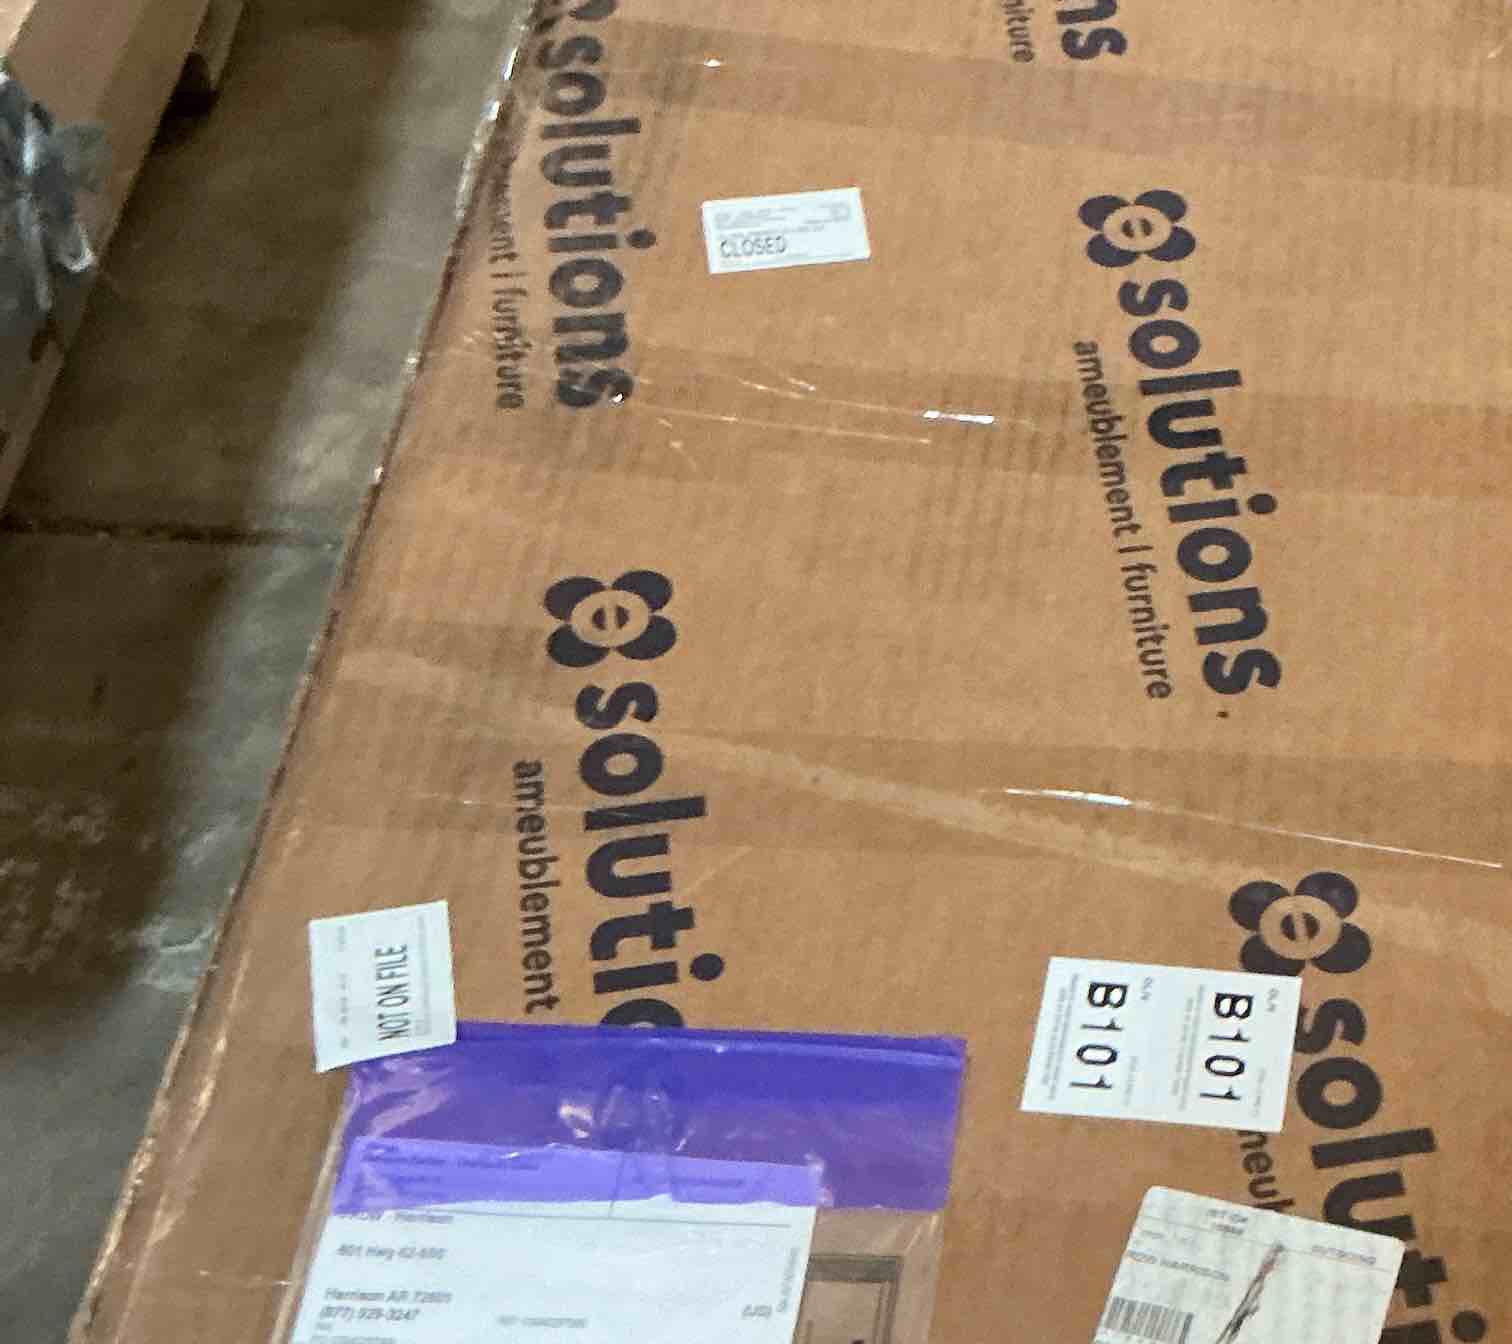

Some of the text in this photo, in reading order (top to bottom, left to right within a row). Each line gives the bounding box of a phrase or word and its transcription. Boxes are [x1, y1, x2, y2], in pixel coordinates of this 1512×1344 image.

[534, 34, 657, 410] solutions
[719, 233, 788, 259] CLOSED
[1073, 339, 1142, 539] ameublement
[1120, 562, 1174, 700] furniture
[1117, 278, 1282, 696] solutions
[512, 759, 562, 1016] ameublement
[374, 942, 411, 1041] NOT ON FILE
[1070, 979, 1129, 1097] B101
[1198, 989, 1255, 1106] B101
